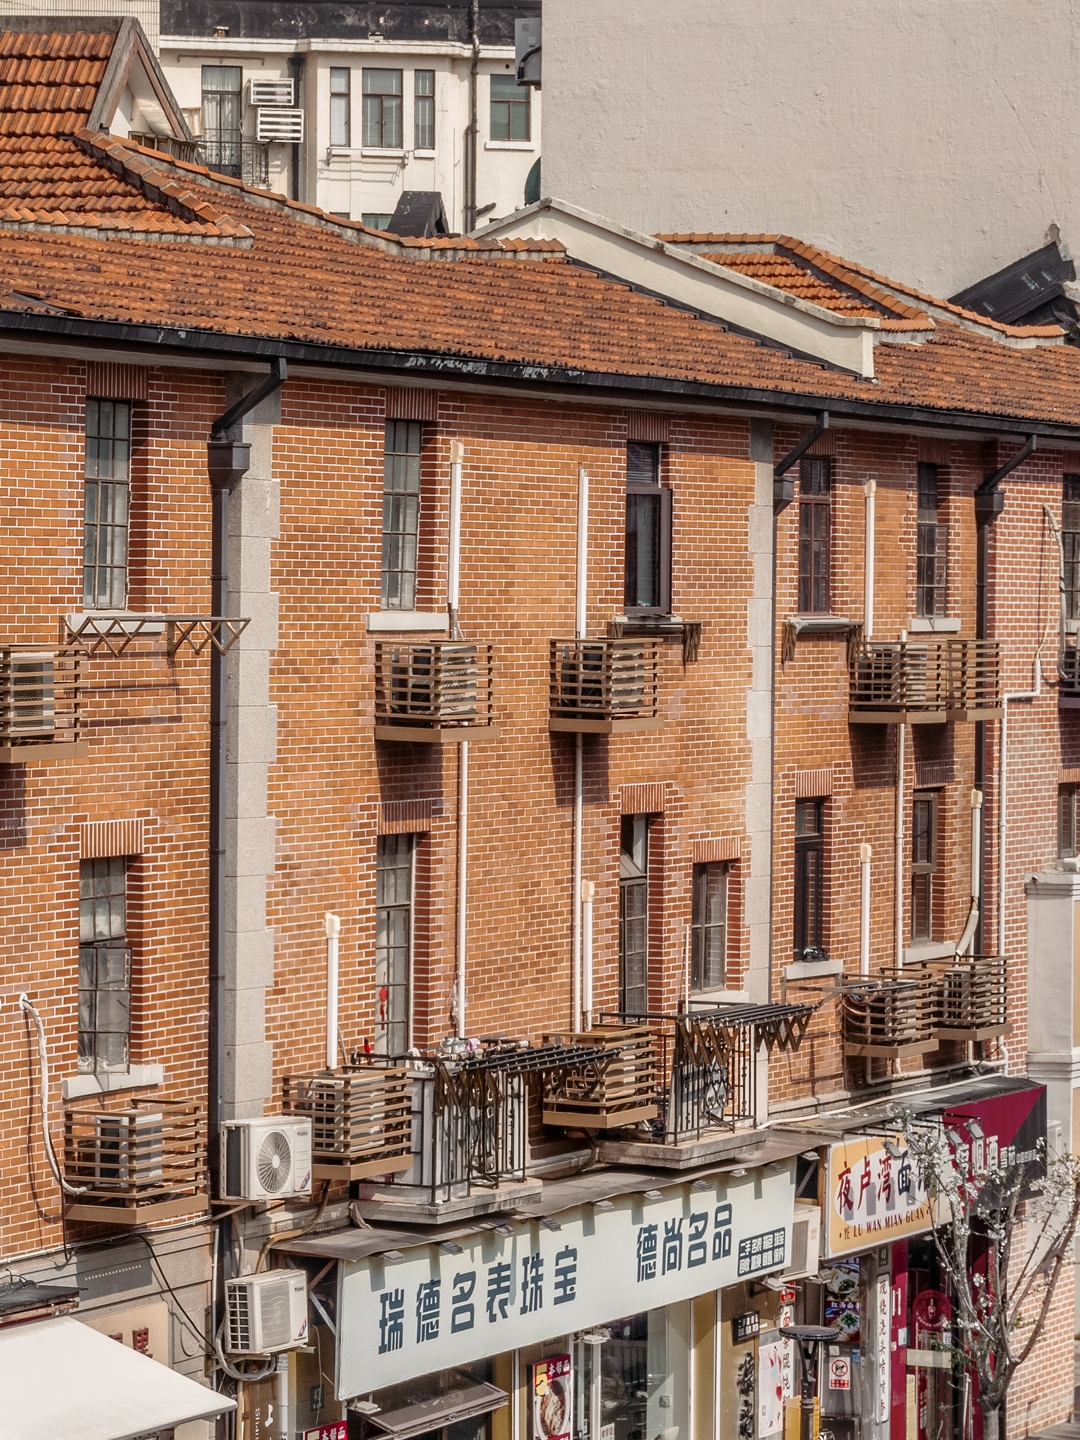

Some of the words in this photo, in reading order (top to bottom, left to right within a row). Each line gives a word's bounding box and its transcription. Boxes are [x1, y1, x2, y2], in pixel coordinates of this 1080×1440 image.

[837, 1147, 934, 1216] 夜卢湾面
[636, 1202, 733, 1284] 德尚名品
[844, 1225, 851, 1241] YE
[853, 1222, 864, 1237] LU
[866, 1217, 882, 1234] WAN
[884, 1212, 903, 1231] MIAN
[905, 1207, 925, 1226] GUAN
[378, 1244, 578, 1355] 瑞德名表珠宝
